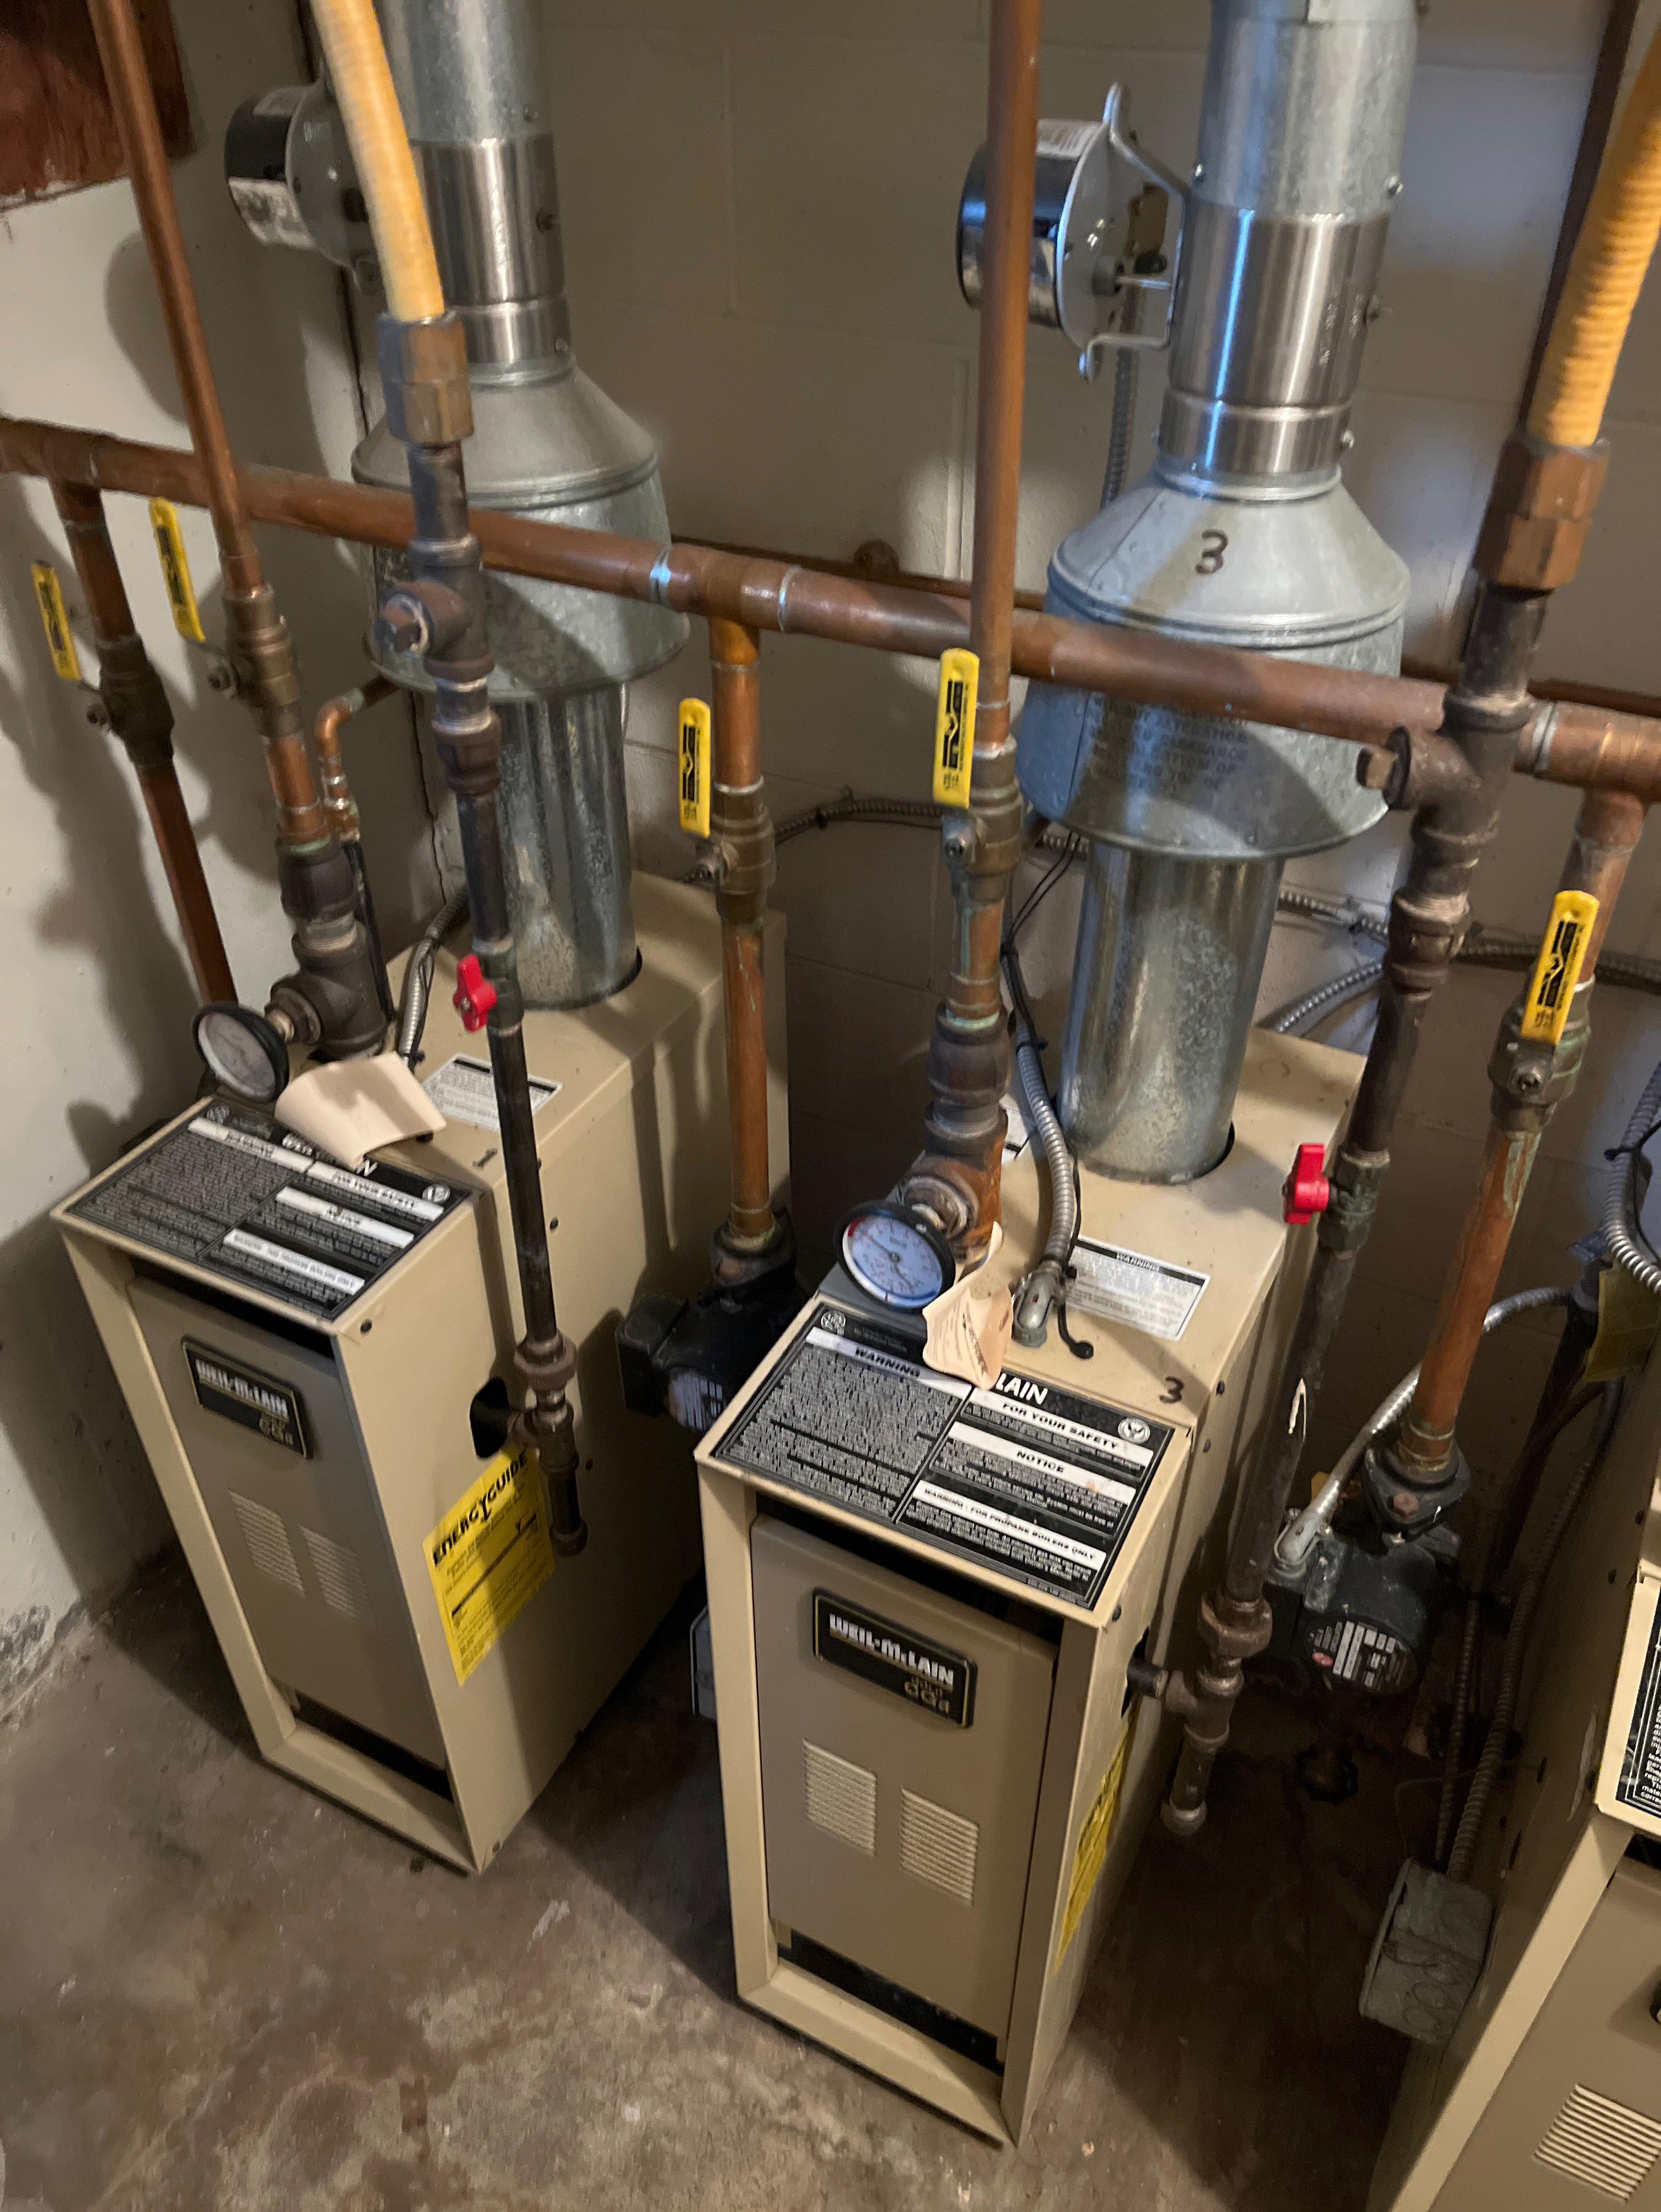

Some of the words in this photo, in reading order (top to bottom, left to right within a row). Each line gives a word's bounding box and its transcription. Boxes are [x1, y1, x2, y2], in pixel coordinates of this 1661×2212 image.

[1195, 529, 1228, 574] 3
[855, 1347, 921, 1377] WARNING
[1159, 1376, 1184, 1403] 3
[1003, 1402, 1027, 1416] FOR
[1032, 1413, 1066, 1431] YOUR
[1070, 1428, 1119, 1450] SAFETY
[1017, 1449, 1064, 1474] NOTICE
